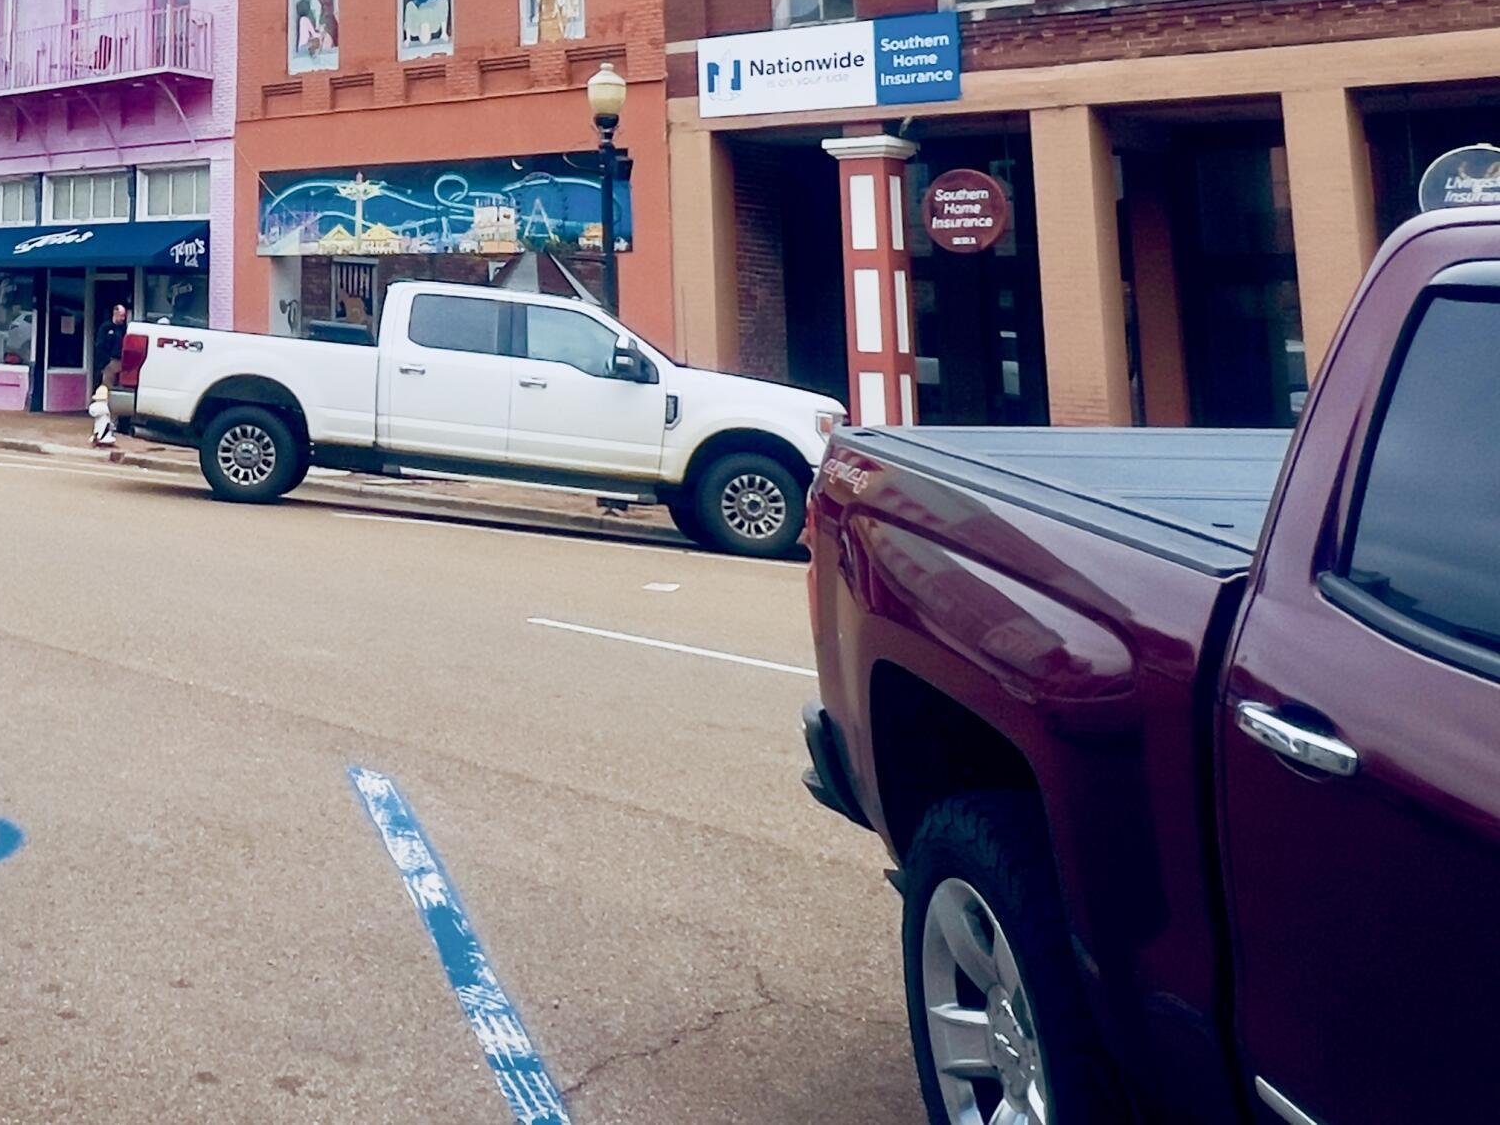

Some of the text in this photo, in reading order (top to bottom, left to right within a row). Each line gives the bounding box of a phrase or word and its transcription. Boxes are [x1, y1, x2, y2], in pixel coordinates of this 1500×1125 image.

[881, 34, 950, 52] Southern
[750, 52, 865, 77] Nationwide
[893, 52, 938, 68] Home
[881, 69, 953, 86] Insurance
[935, 188, 989, 202] Southern
[944, 203, 981, 215] Home
[932, 216, 993, 229] Insurance
[170, 238, 205, 264] Tom's
